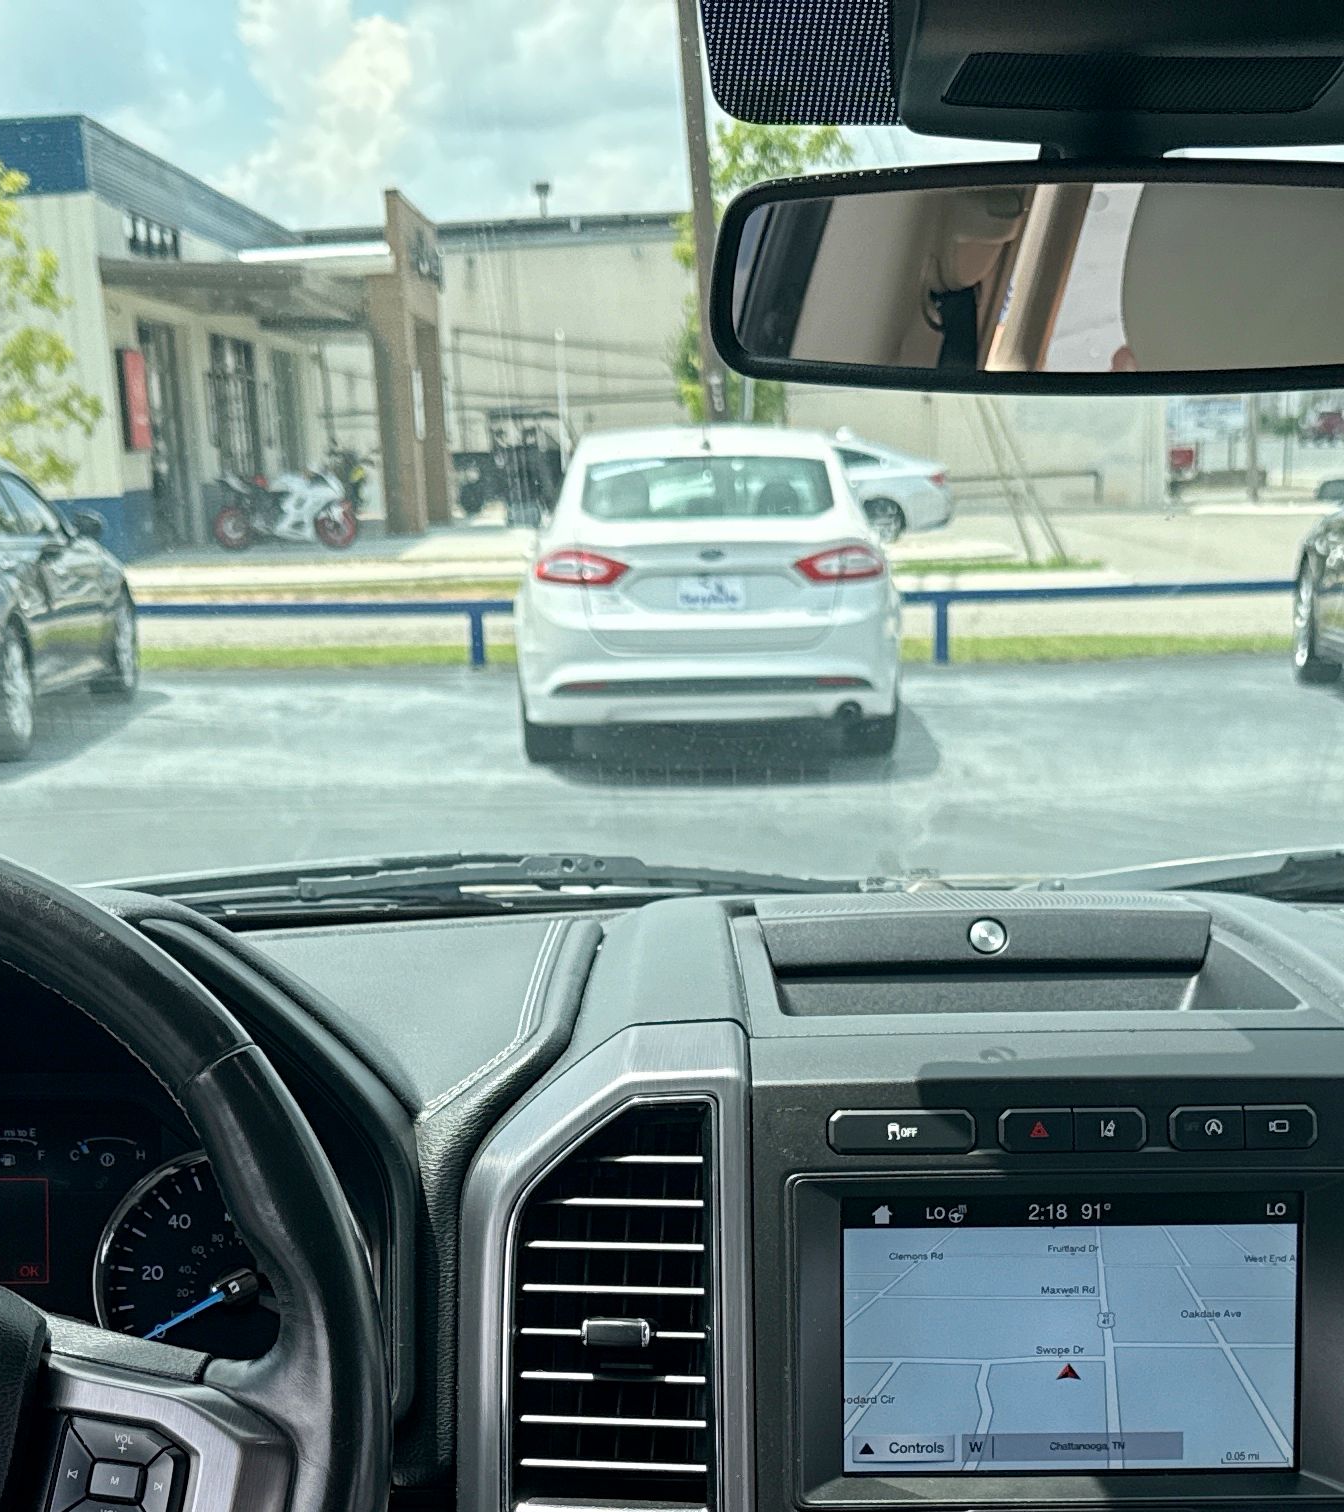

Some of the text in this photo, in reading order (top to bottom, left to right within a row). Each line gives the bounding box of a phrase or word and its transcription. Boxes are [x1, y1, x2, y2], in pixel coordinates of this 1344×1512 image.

[900, 1127, 917, 1138] OFF
[926, 1207, 946, 1220] LO
[1028, 1204, 1068, 1221] 2:18
[1266, 1203, 1287, 1216] LO
[168, 1213, 191, 1229] 40
[1088, 1244, 1099, 1253] Dr
[889, 1252, 944, 1261] Clemons Rd
[1244, 1255, 1267, 1263] West
[1270, 1255, 1287, 1263] End
[19, 1265, 40, 1277] OK
[141, 1265, 164, 1281] 20
[1041, 1286, 1095, 1295] Maxwell Rd
[1180, 1310, 1242, 1319] Oakdale Ave
[1036, 1346, 1084, 1356] Swope Dr
[880, 1395, 895, 1404] Cir
[114, 1433, 134, 1445] VOL
[888, 1442, 945, 1454] Controls
[969, 1441, 983, 1453] W
[1112, 1441, 1125, 1450] TN
[1225, 1451, 1260, 1461] 0.05 mi
[110, 1476, 120, 1486] M
